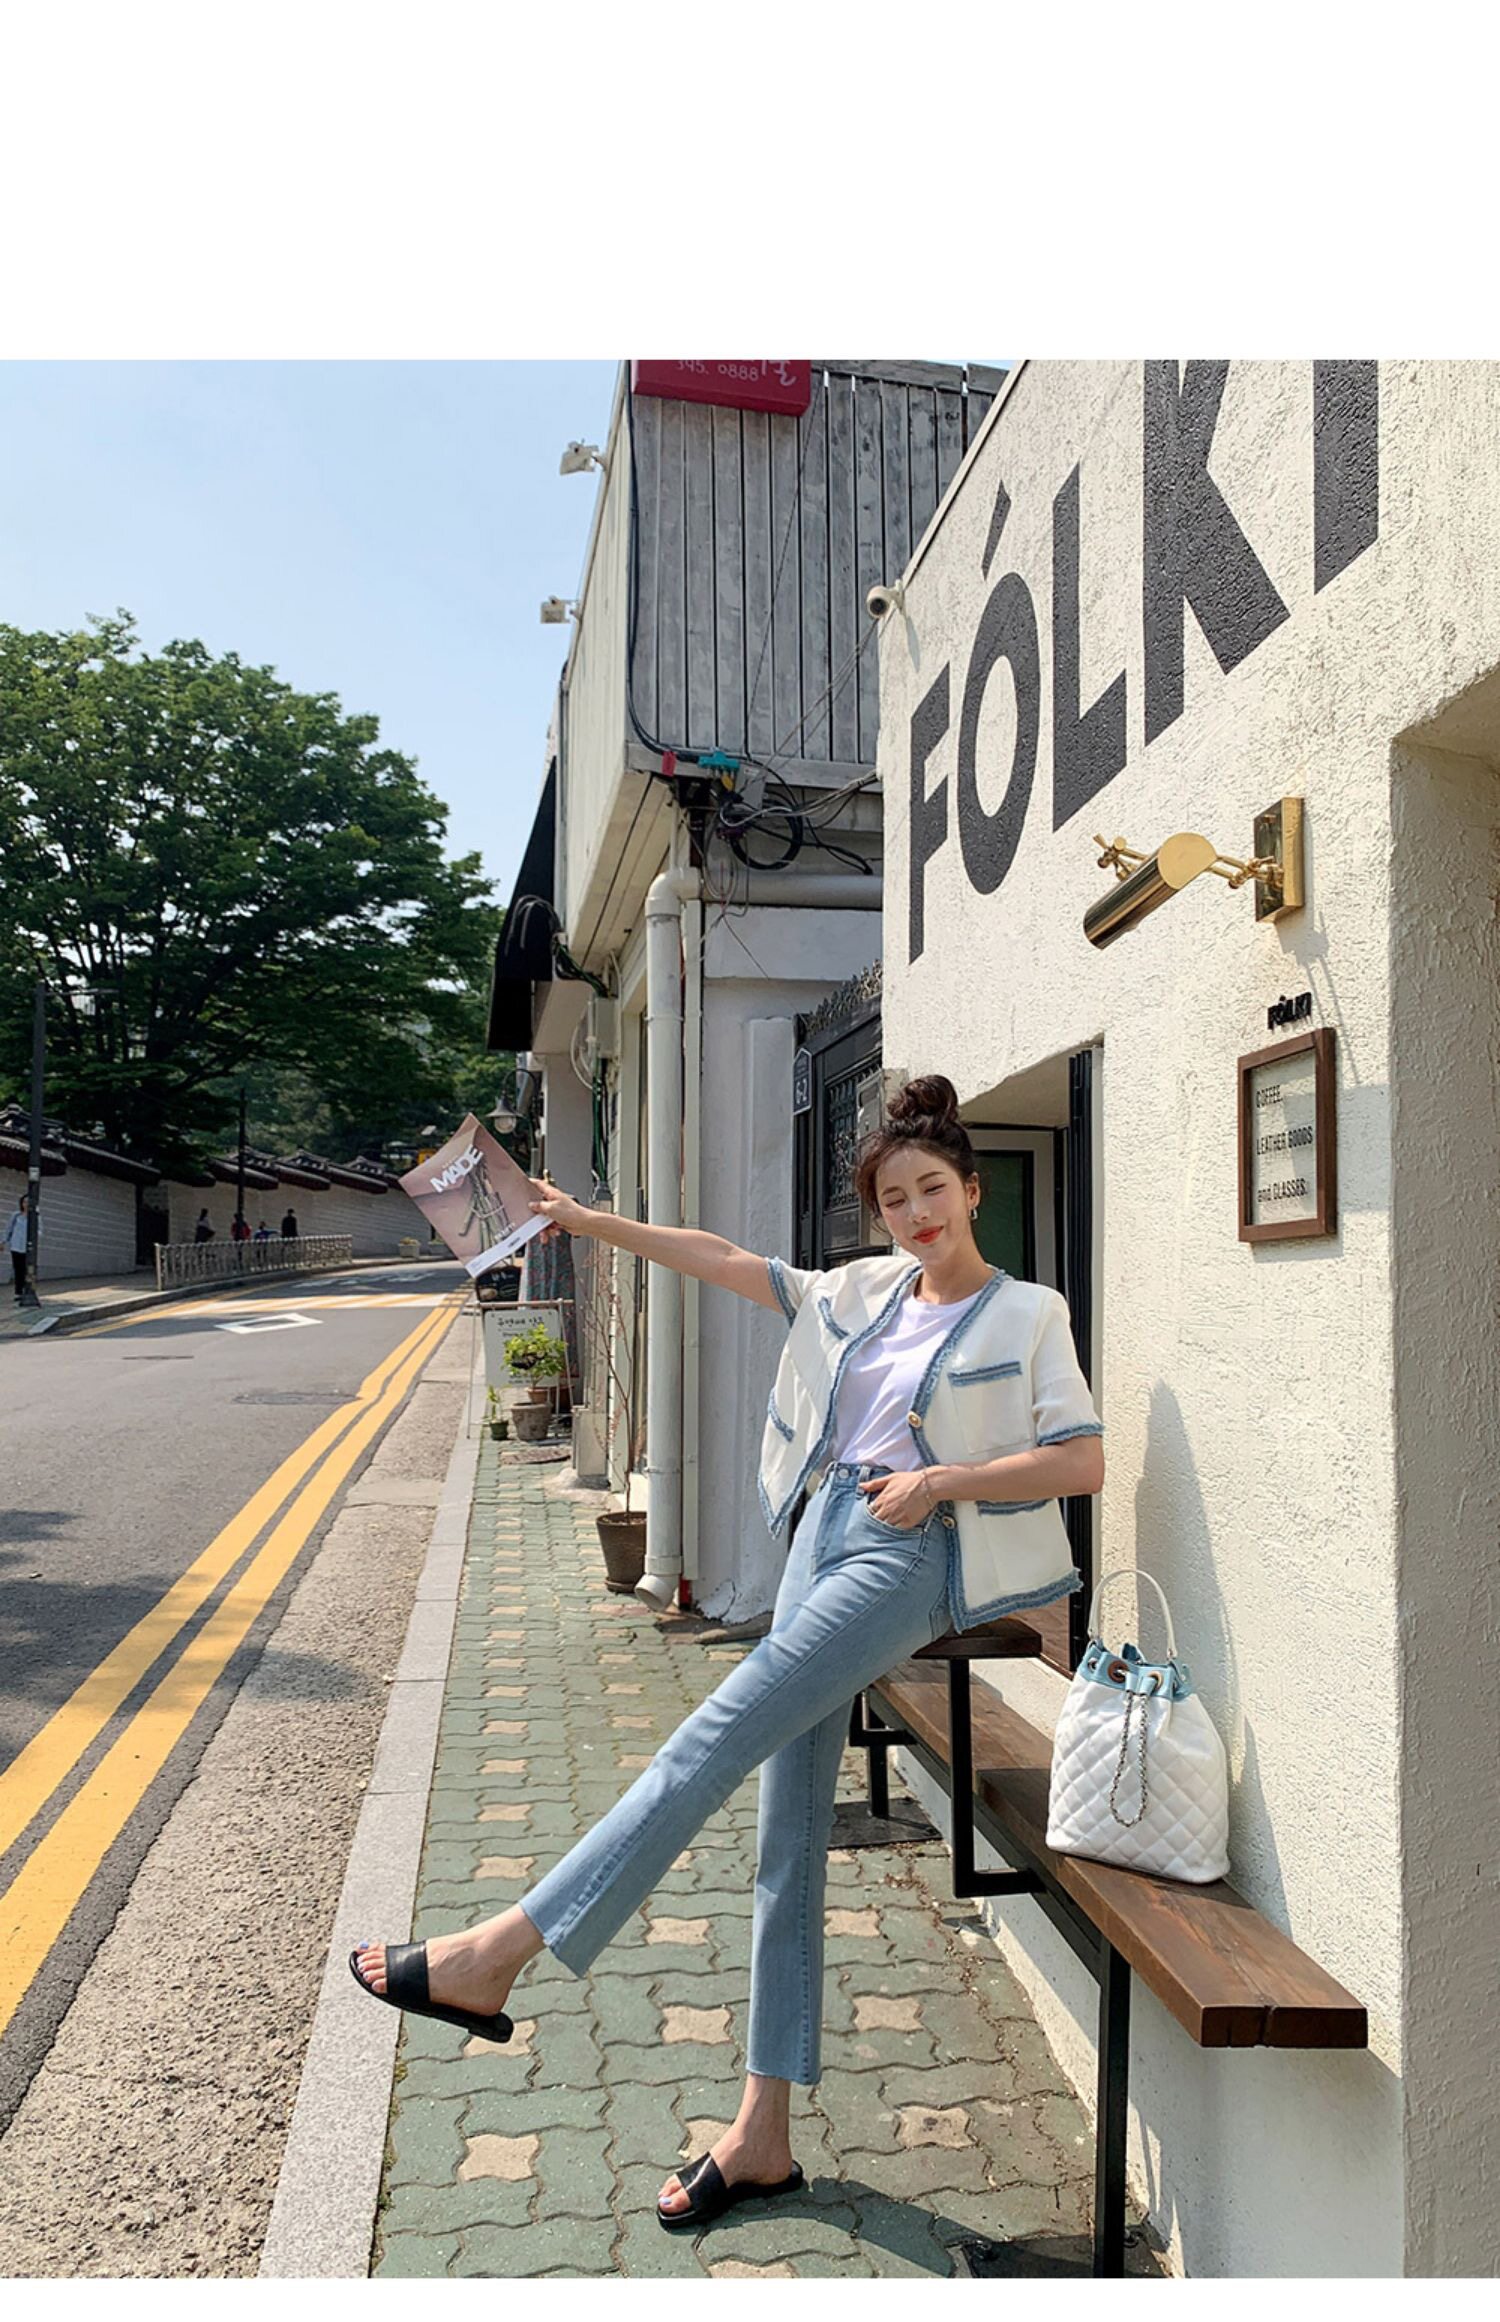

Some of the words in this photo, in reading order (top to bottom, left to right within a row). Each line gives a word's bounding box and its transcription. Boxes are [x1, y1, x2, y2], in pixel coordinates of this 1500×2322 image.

[718, 365, 758, 382] 0888
[1256, 1132, 1287, 1155] LEATHER
[1288, 1126, 1313, 1149] GOODS
[429, 1143, 484, 1193] MADE
